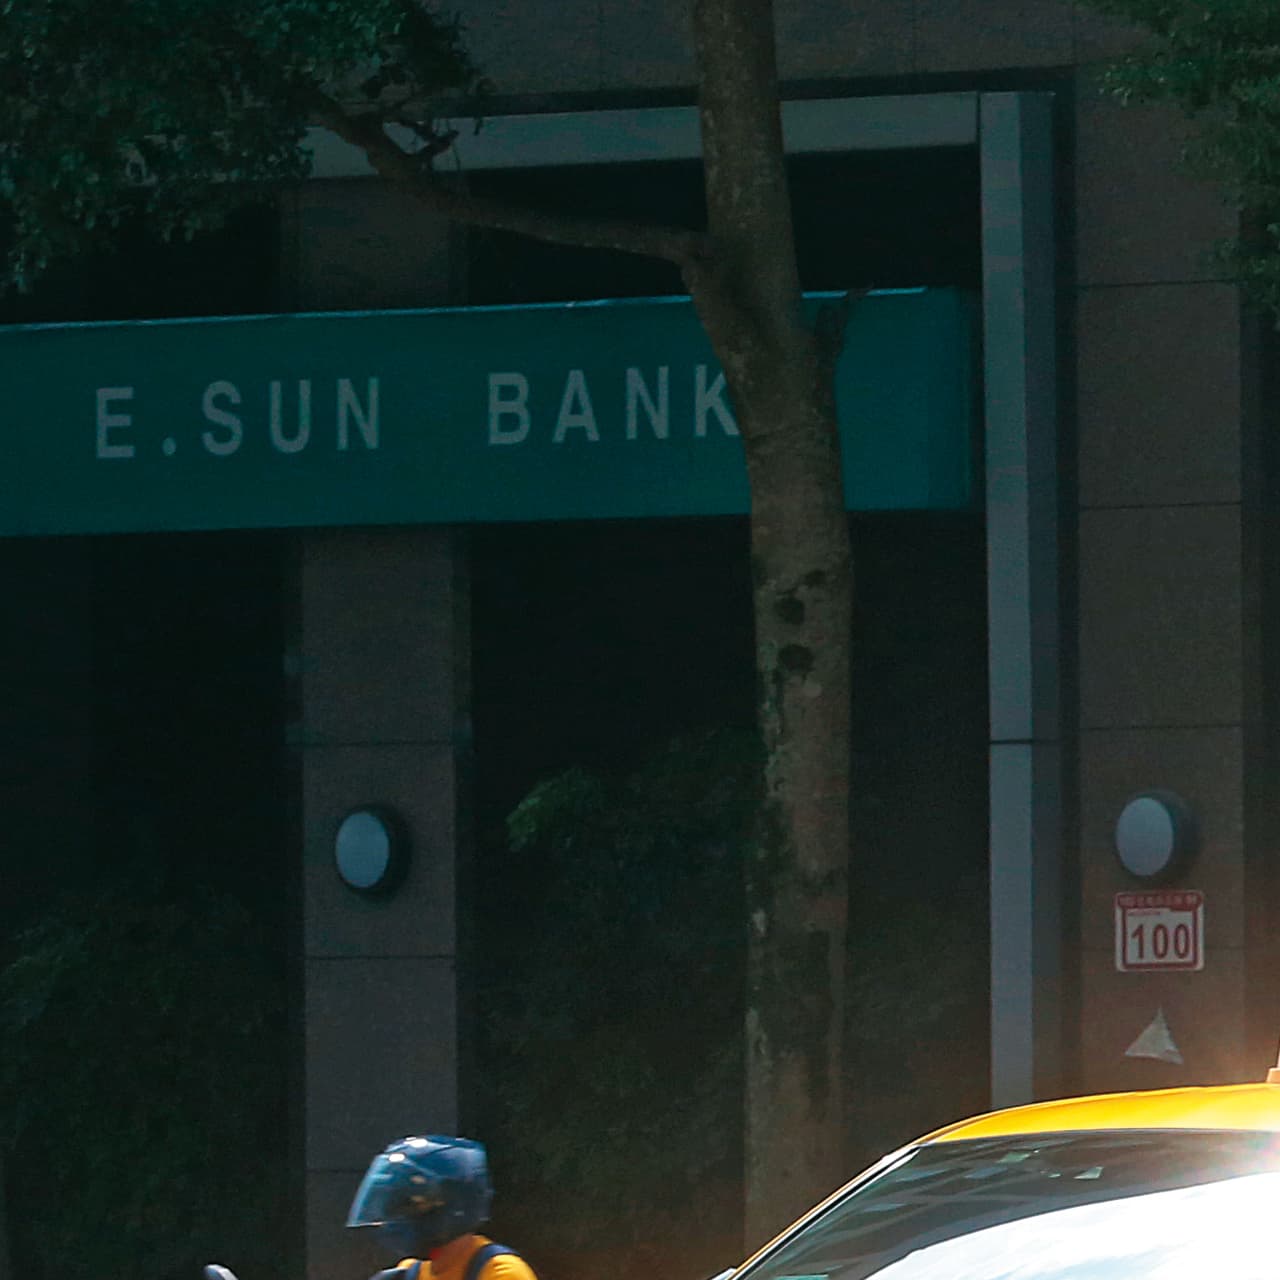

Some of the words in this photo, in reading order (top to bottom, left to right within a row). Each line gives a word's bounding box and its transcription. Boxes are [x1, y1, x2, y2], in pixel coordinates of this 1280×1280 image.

[96, 377, 380, 458] E.SUN
[487, 363, 740, 445] BANK
[1131, 923, 1190, 960] 100
